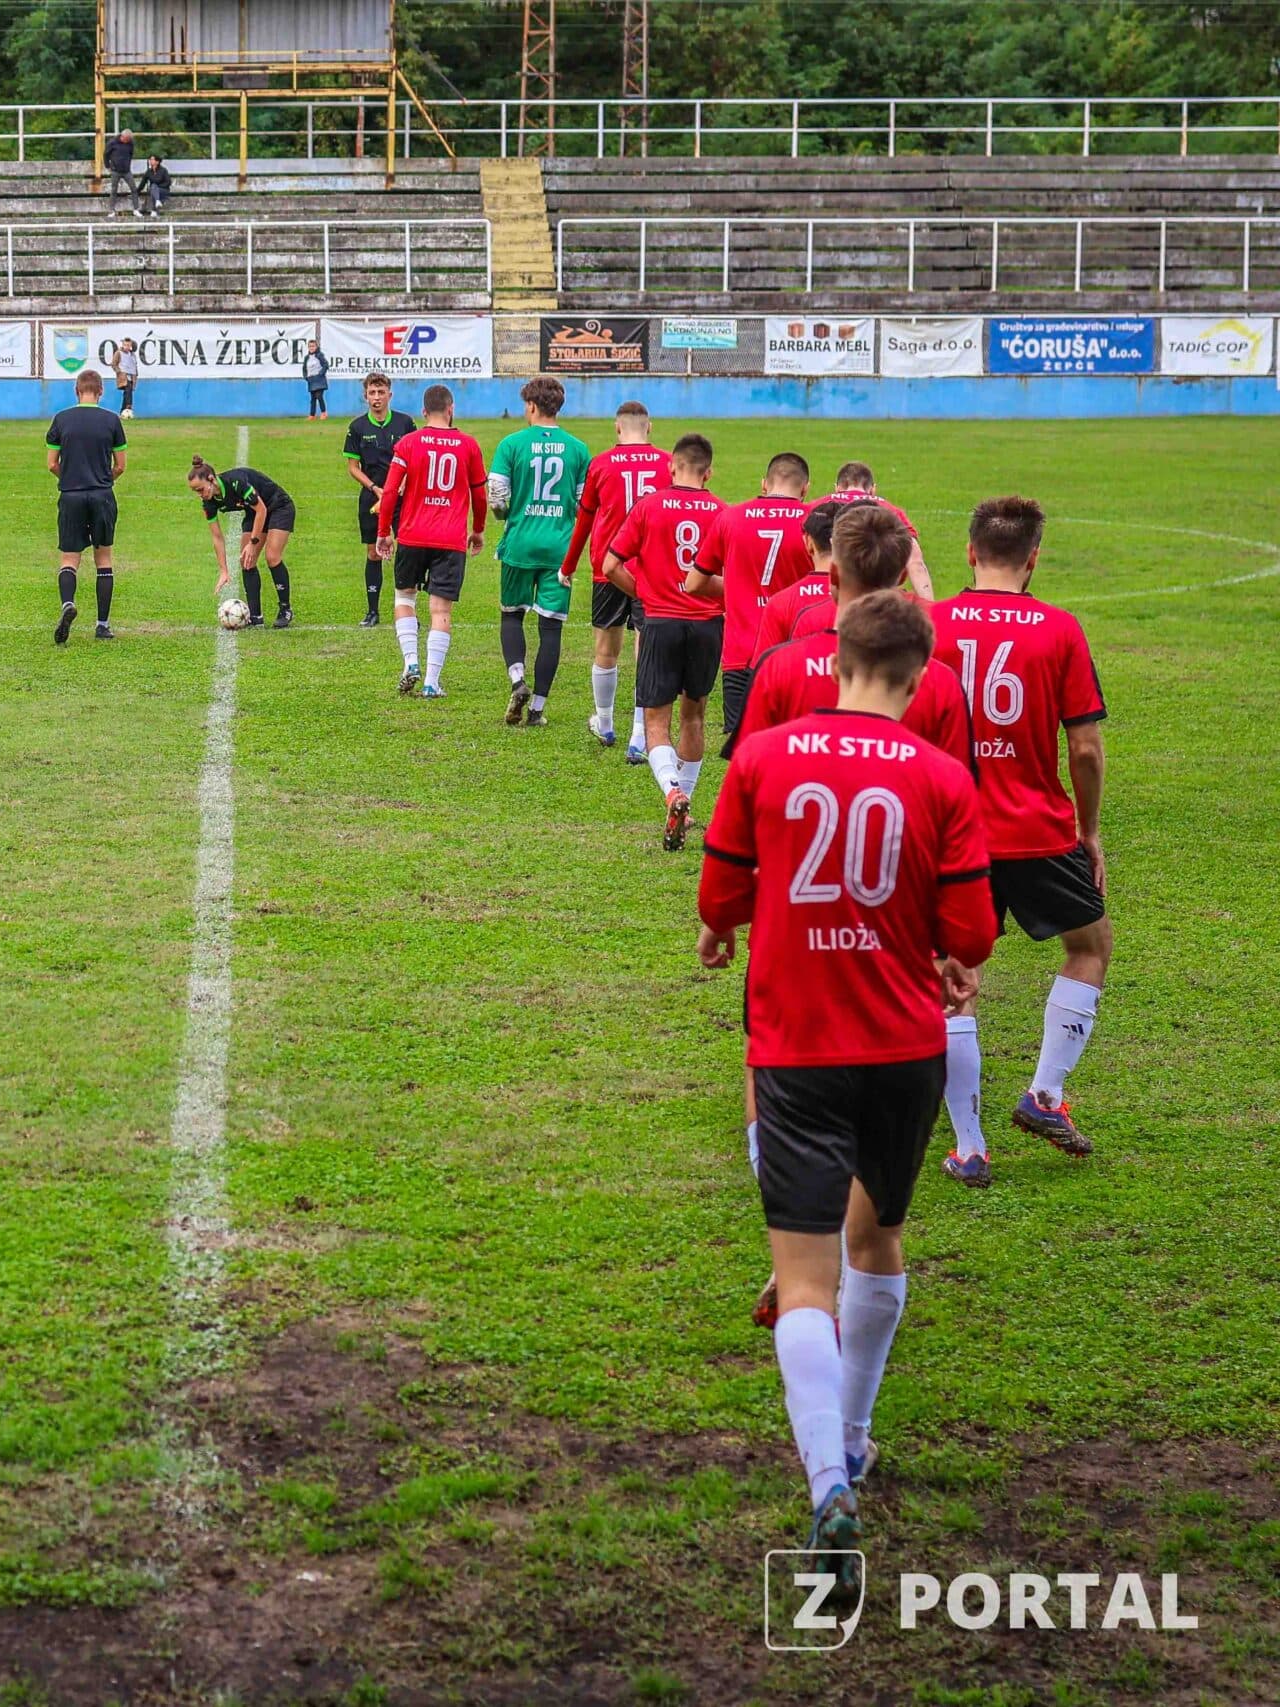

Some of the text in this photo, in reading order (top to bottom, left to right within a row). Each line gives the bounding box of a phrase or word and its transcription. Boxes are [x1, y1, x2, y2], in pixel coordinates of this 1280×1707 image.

[769, 339, 871, 353] BARBARA MEBL
[888, 337, 977, 354] Saga d.o.o.
[1216, 341, 1248, 353] COP
[348, 356, 483, 369] ELEKTROPRIVREDA
[420, 435, 462, 449] NK STUP
[610, 453, 660, 464] NK STUP
[427, 451, 458, 492] 10
[529, 457, 564, 502] 12
[662, 498, 718, 512] NK STUP
[745, 508, 805, 518] NK STUP
[675, 520, 700, 571] 8
[757, 529, 784, 586] 7
[799, 583, 824, 597] NK
[951, 607, 1045, 626] NK STUP
[956, 639, 1024, 726] 16
[787, 734, 916, 762] NK STUP
[974, 737, 1016, 758] IDŽA
[785, 782, 904, 907] 20
[808, 922, 882, 951] ILIDŽA
